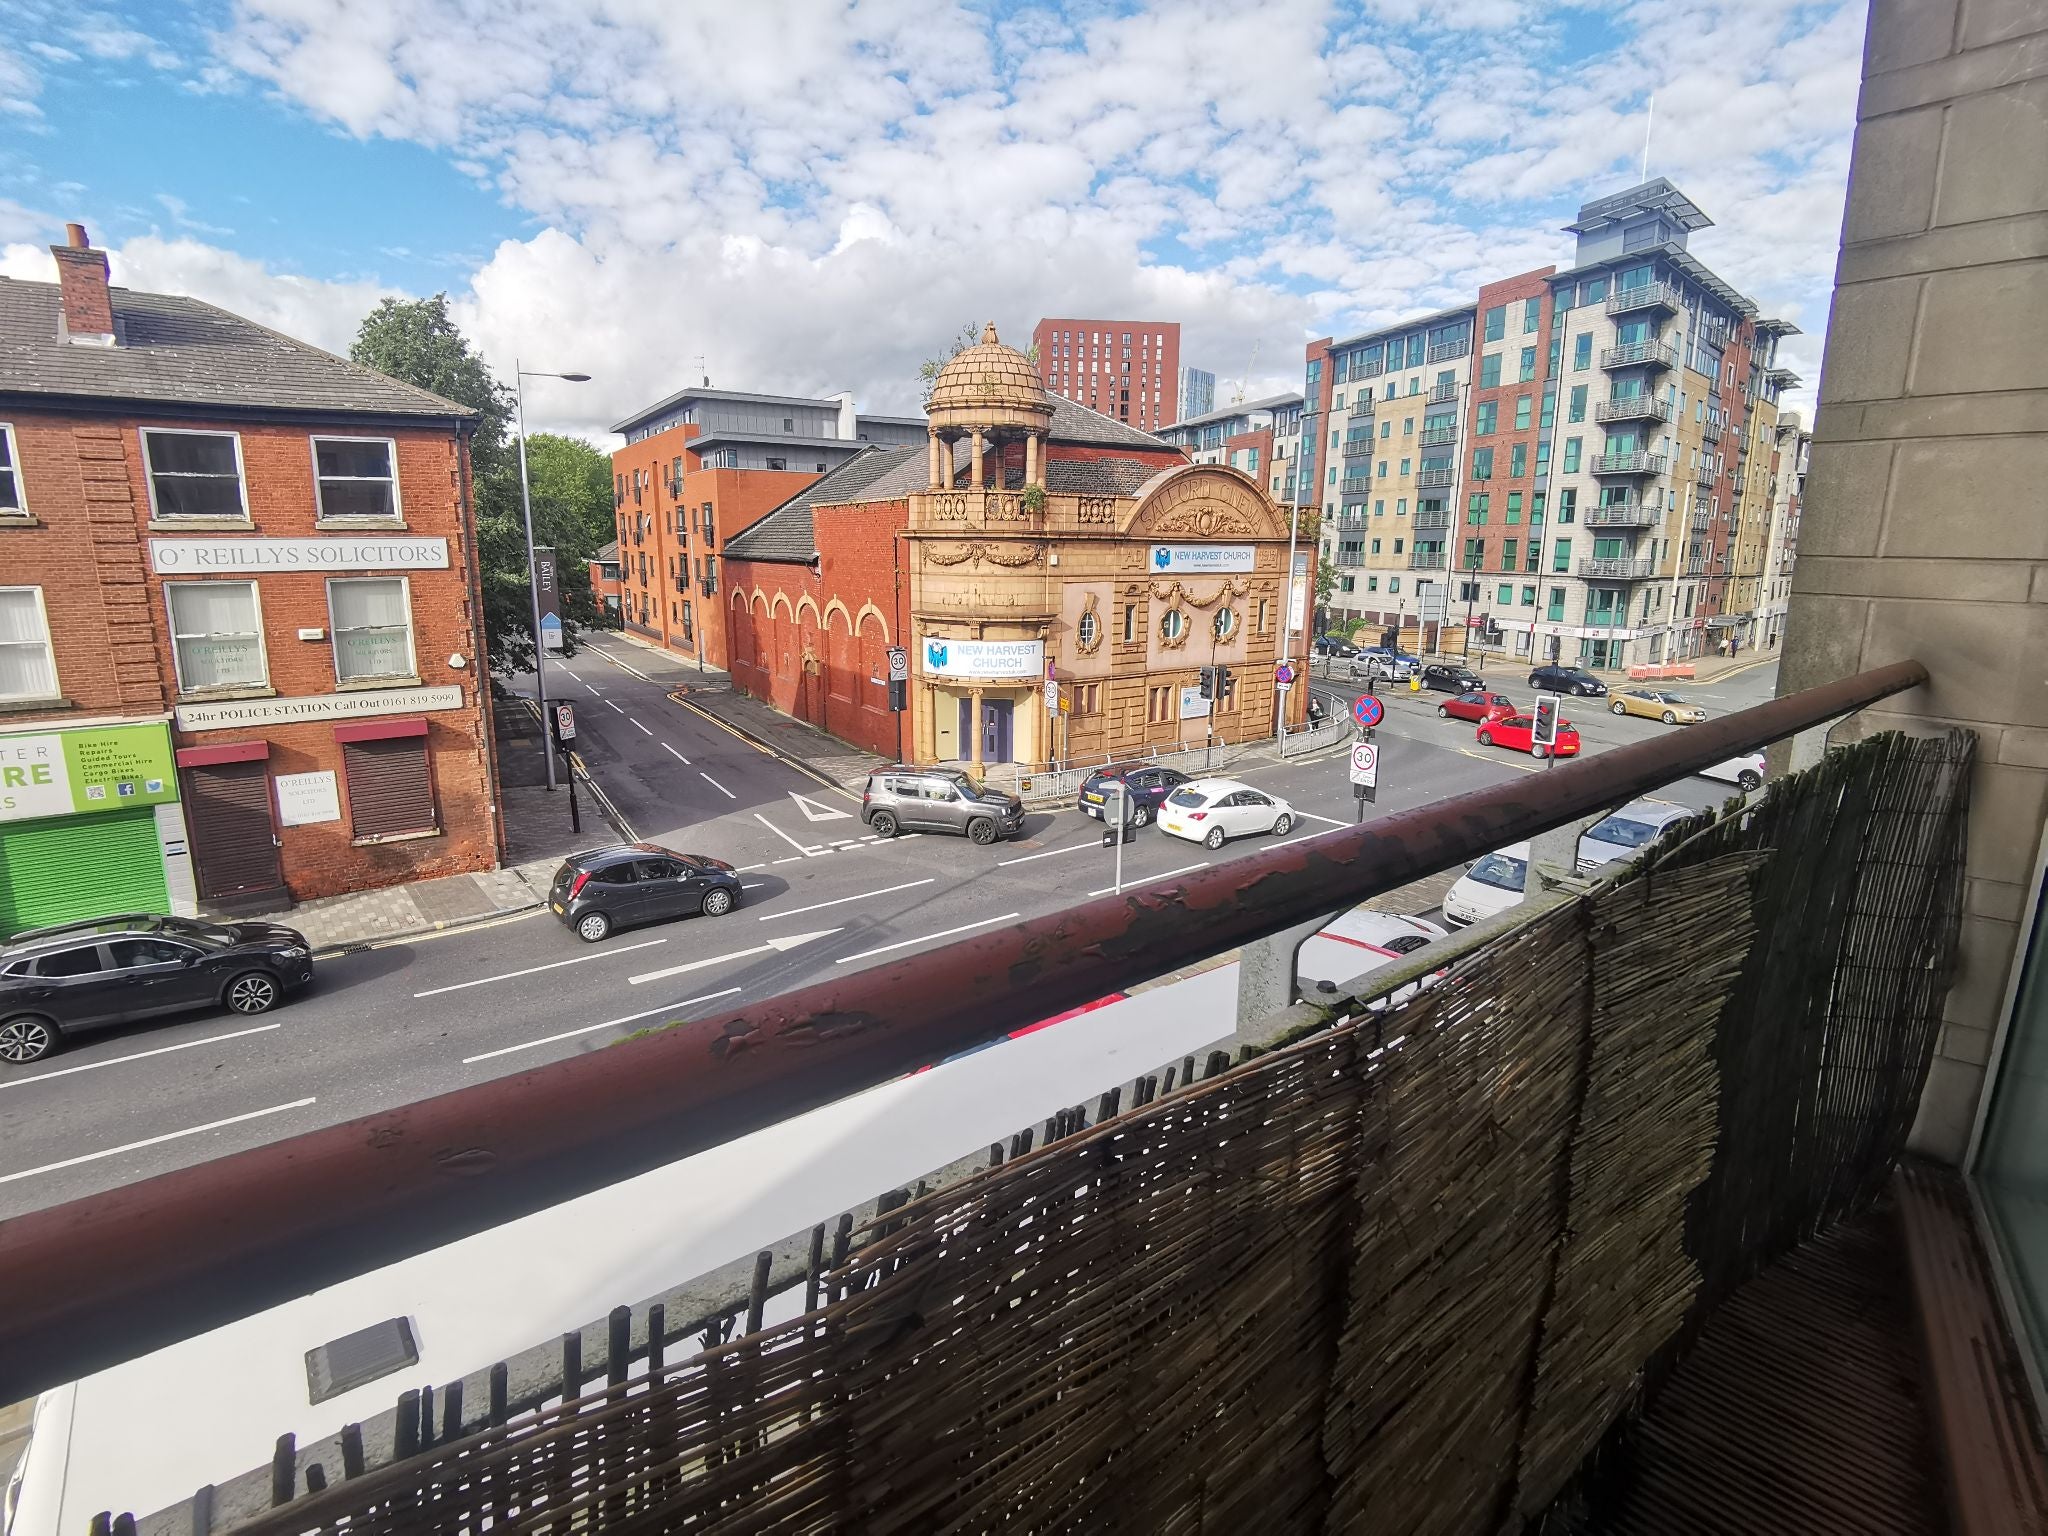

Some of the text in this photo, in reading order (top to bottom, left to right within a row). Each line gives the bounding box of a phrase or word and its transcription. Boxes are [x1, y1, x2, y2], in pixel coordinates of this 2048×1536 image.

[1140, 478, 1264, 534] SALFORD CINEMA
[196, 547, 300, 565] REILLYS
[307, 545, 442, 563] SOLICITORS
[1174, 551, 1251, 560] NEW HARVEST CHURCH
[540, 561, 552, 593] BAILEY
[957, 644, 1037, 655] NEW HARVEST
[894, 657, 904, 665] 30
[972, 657, 1023, 668] CHURCH
[187, 712, 216, 723] 24hr
[219, 707, 271, 720] POLICE
[274, 702, 331, 715] STATION
[334, 700, 356, 711] Call
[359, 699, 380, 709] Out
[382, 697, 407, 707] 0161
[410, 695, 428, 705] 819
[560, 712, 571, 722] 30
[80, 748, 113, 756] Repairs
[1356, 751, 1372, 763] 30
[81, 755, 111, 763] Guided
[82, 761, 133, 770] Commercial
[85, 776, 119, 784] Electric
